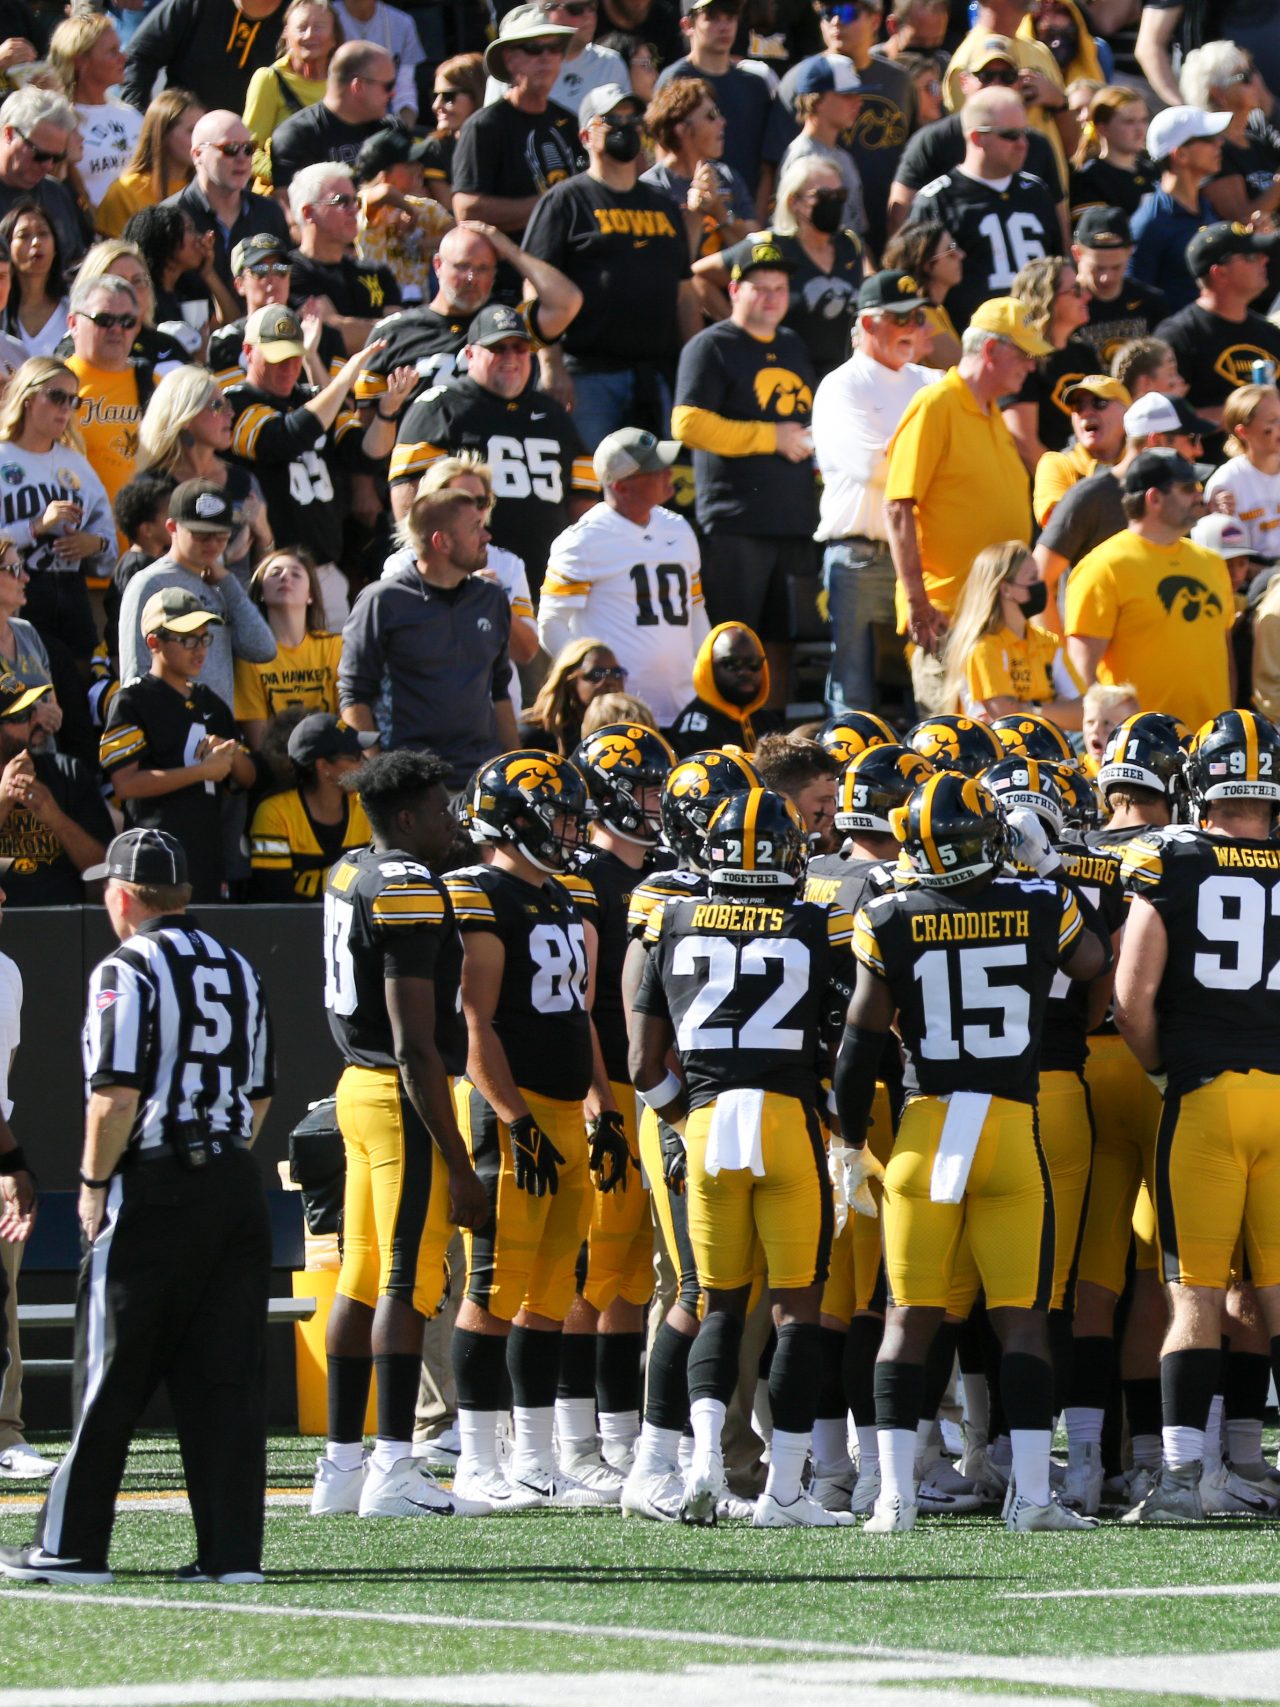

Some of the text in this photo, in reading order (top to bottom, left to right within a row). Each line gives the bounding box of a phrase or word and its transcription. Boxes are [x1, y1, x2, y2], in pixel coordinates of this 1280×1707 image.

[594, 208, 678, 237] IOWA
[978, 211, 1045, 290] 16
[81, 396, 142, 425] Haw
[488, 435, 563, 503] 65
[630, 563, 689, 626] 10
[678, 711, 709, 733] 15
[1103, 739, 1140, 763] 91
[1229, 752, 1273, 775] 92
[1012, 769, 1052, 793] 97
[1006, 794, 1058, 817] TOGETHER
[727, 839, 774, 863] 22
[915, 844, 958, 871] 15
[377, 860, 432, 880] 93
[722, 871, 779, 885] TOGETHER
[922, 869, 976, 887] TOGETHER
[691, 904, 785, 932] ROBERTS
[911, 909, 1029, 943] CRADDIETH
[529, 923, 588, 1014] 80
[672, 936, 811, 1050] 22
[913, 943, 1031, 1060] 15
[191, 964, 232, 1055] S
[212, 1141, 222, 1154] S
